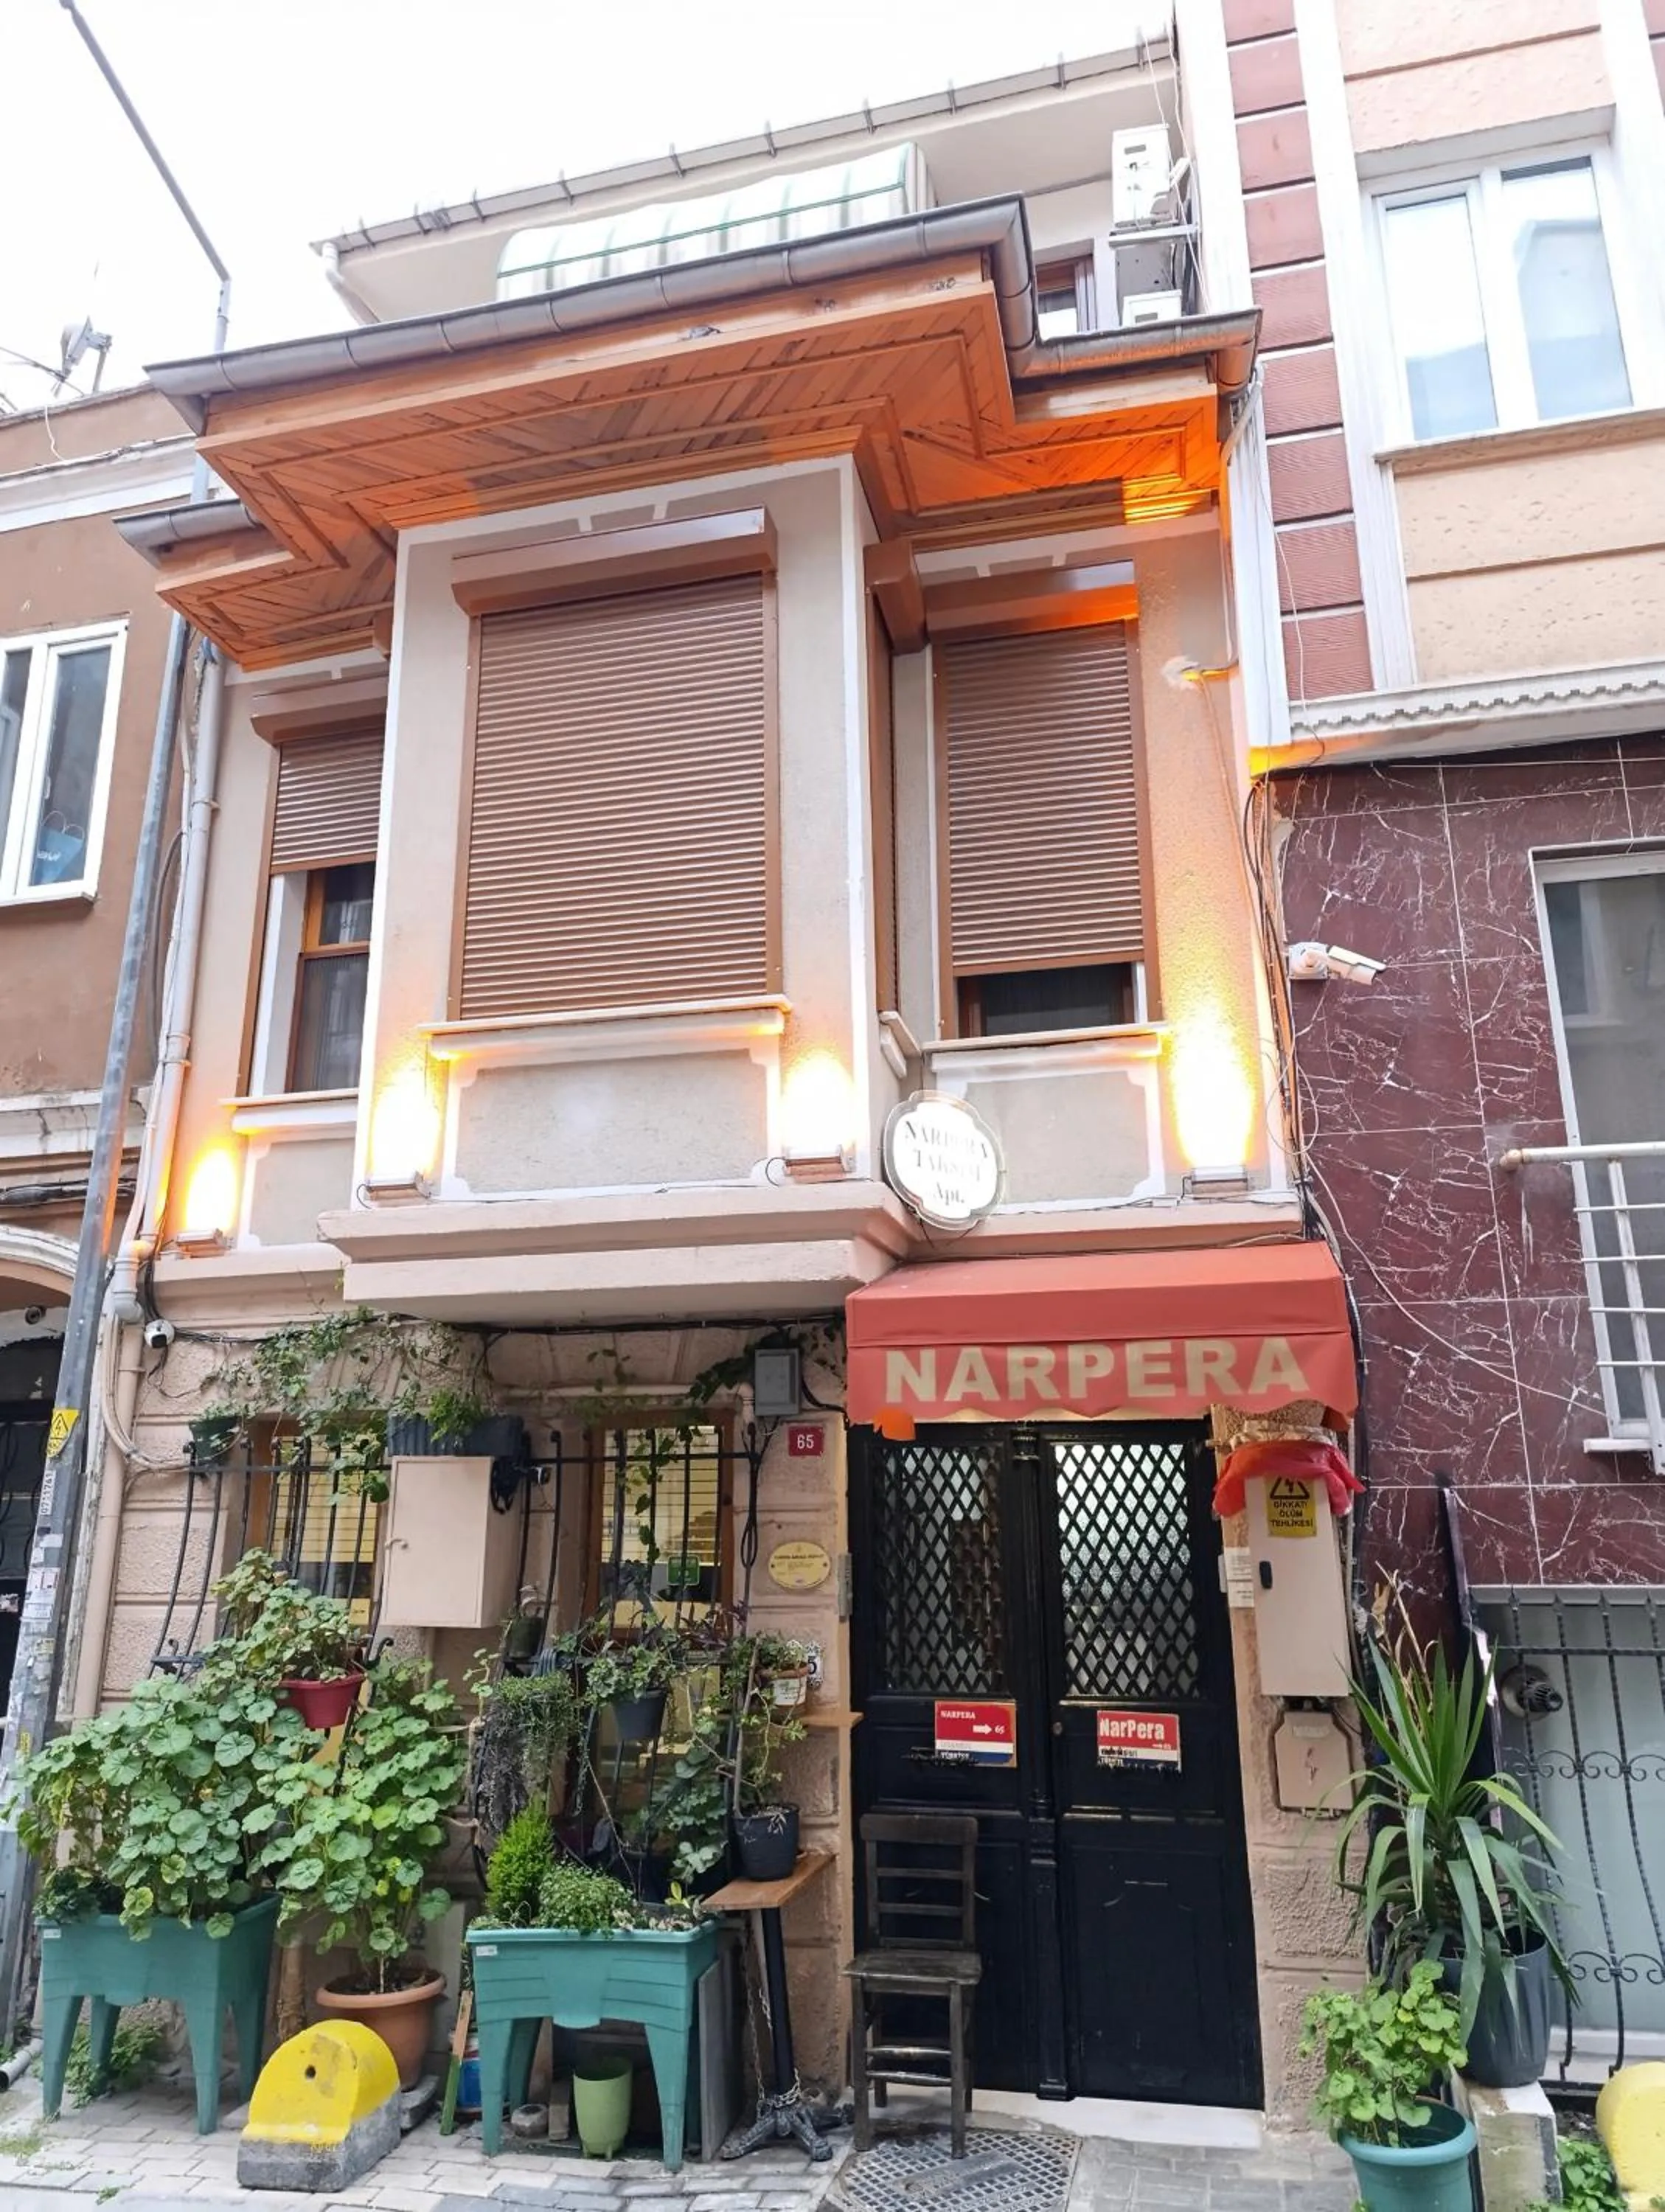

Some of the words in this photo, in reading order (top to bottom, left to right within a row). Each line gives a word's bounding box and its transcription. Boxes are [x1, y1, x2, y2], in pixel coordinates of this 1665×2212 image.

[884, 1337, 1309, 1402] NARPERA
[797, 1433, 815, 1450] 65
[940, 1710, 976, 1719] NARPERA
[1099, 1718, 1165, 1741] NarPera
